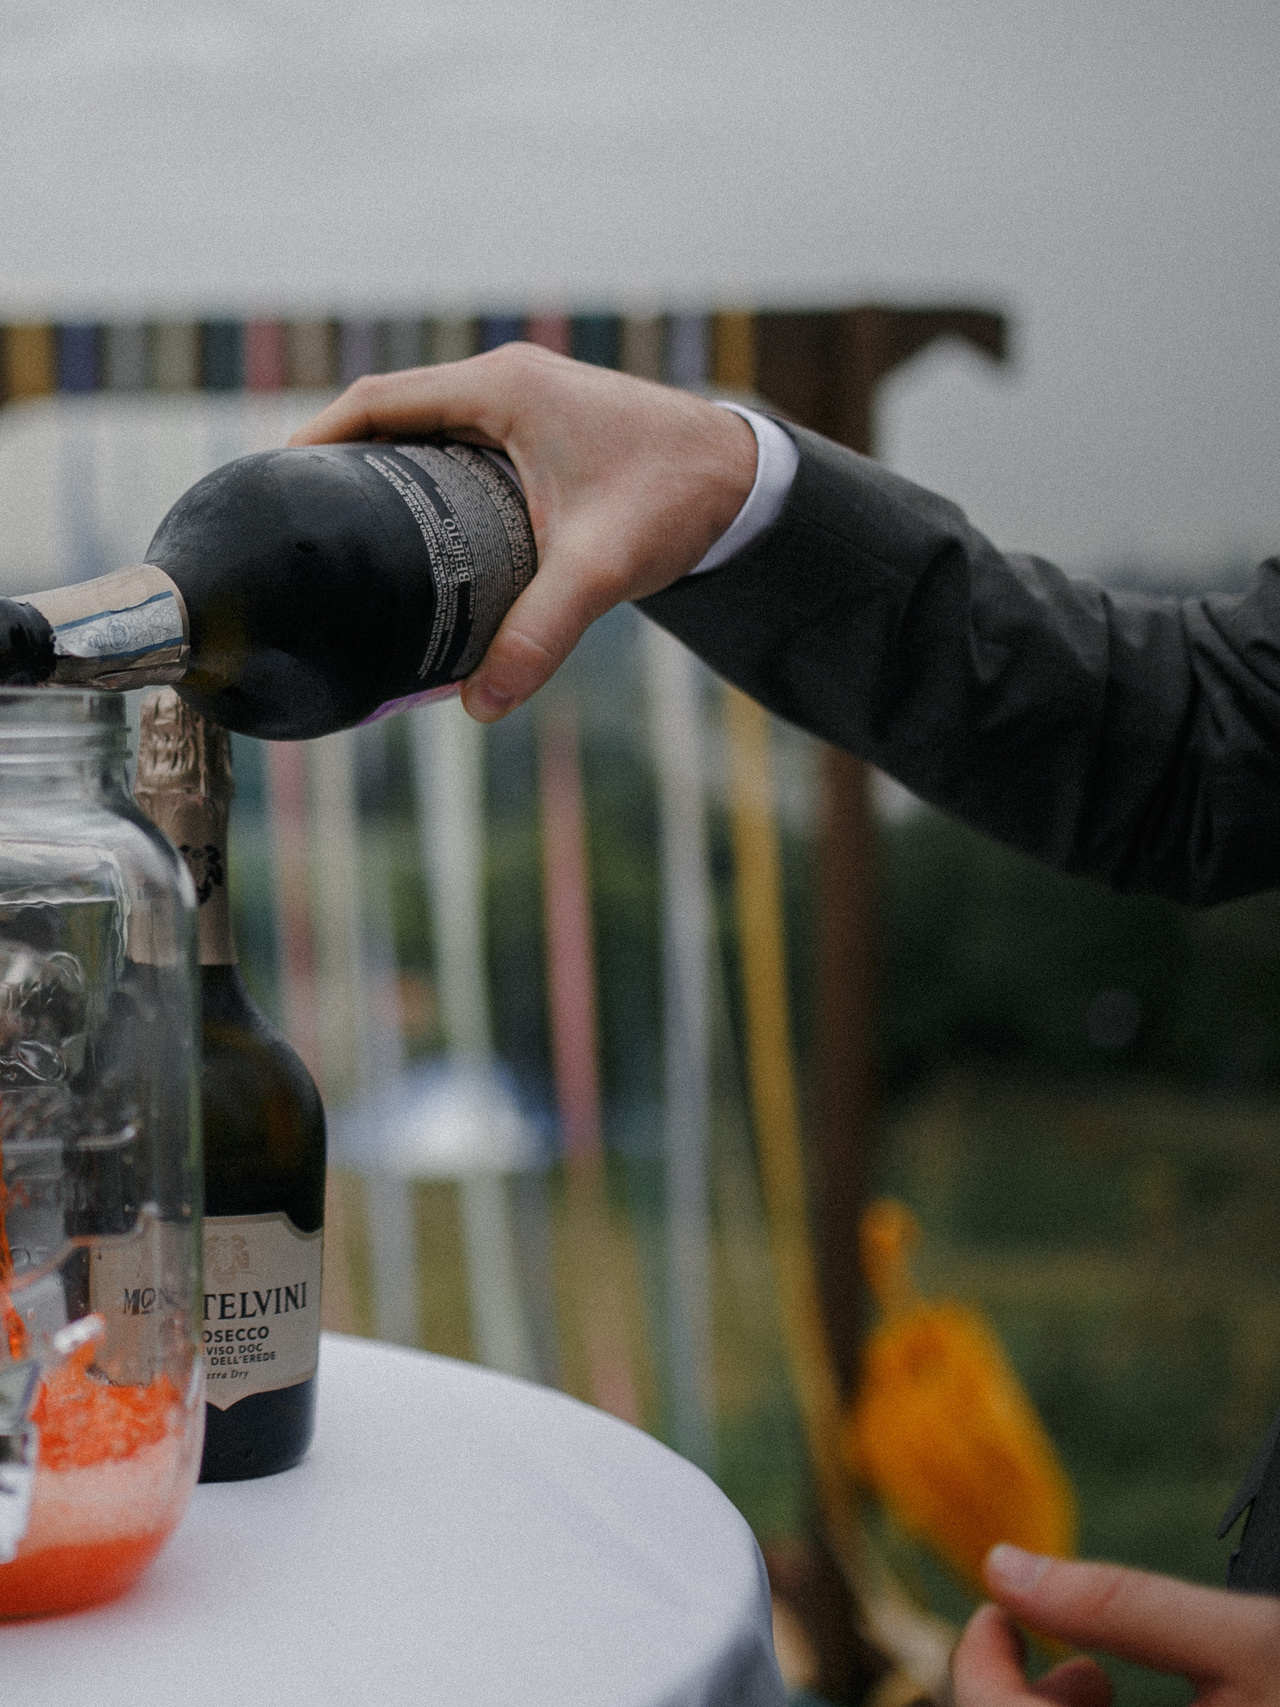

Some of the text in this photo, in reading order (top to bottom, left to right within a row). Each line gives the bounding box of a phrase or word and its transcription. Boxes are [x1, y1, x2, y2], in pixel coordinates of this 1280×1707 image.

[403, 495, 422, 524] CUVEE
[434, 485, 455, 513] СУХОЕ
[420, 525, 435, 565] TREVISO
[443, 517, 470, 582] ВЕНЕТО
[464, 543, 472, 562] DOC
[436, 556, 447, 609] ПРОСЕККО
[442, 555, 453, 601] ИГРИСТОЕ
[448, 556, 458, 587] МЕСТА
[432, 566, 441, 617] PROSECCO
[444, 605, 452, 630] ВИНО
[204, 1326, 269, 1343] OSECCO
[206, 1343, 264, 1356] VISO DOC
[211, 1351, 277, 1366] DELL'EREDE
[207, 1369, 249, 1380] xtra Dry
